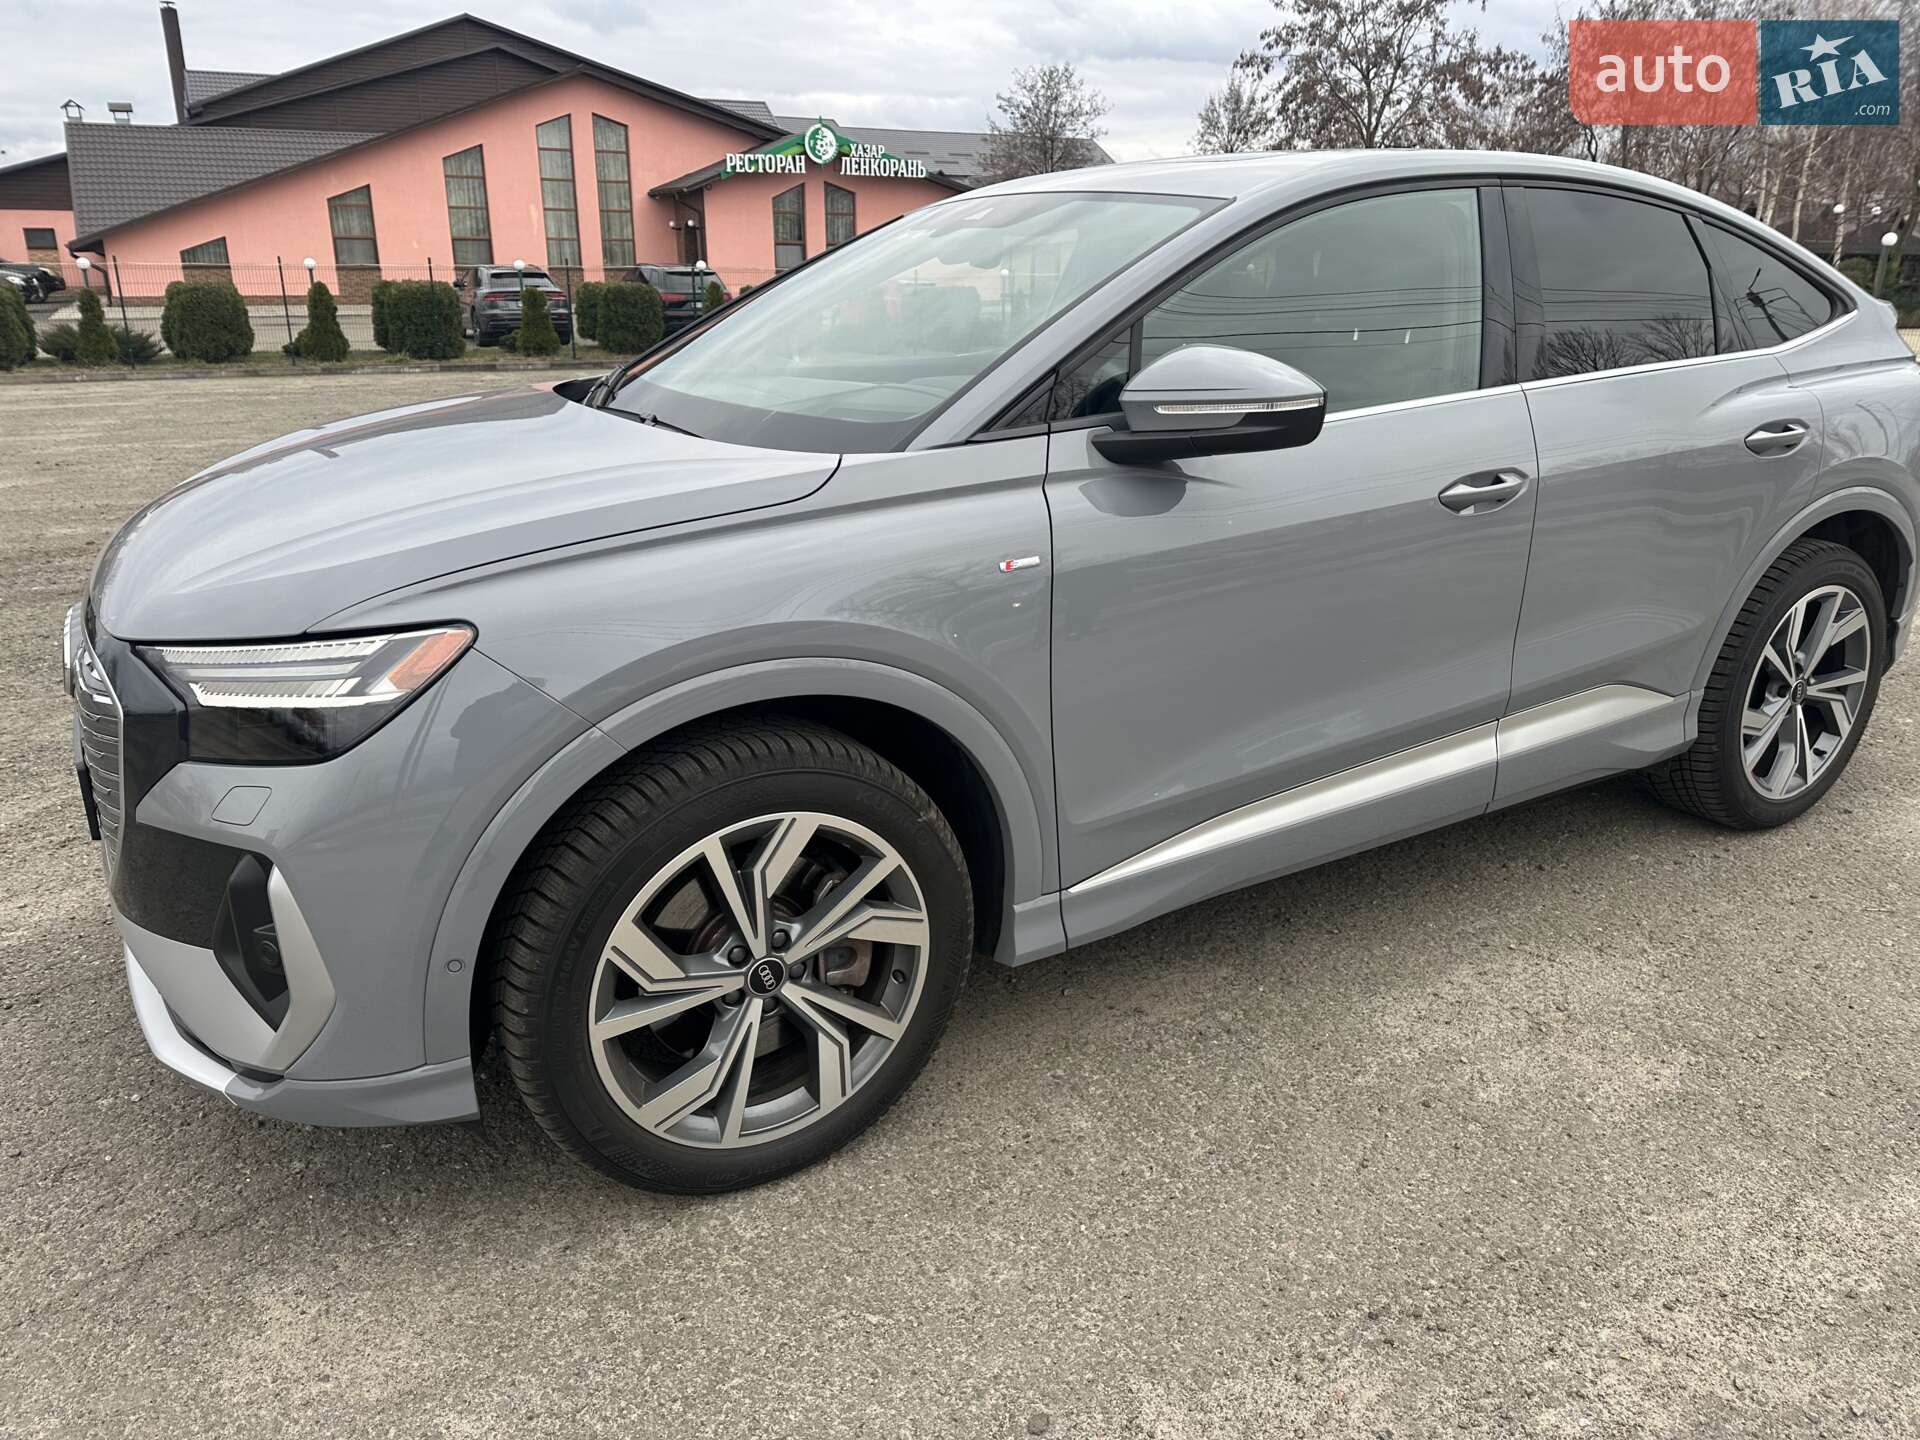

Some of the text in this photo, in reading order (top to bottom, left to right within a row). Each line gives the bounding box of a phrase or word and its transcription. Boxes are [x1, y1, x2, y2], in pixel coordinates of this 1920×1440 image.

[849, 143, 885, 158] ХАЗАР
[725, 153, 806, 174] РЕСТОРАН
[839, 156, 927, 179] ЛЕНКОРАНЬ
